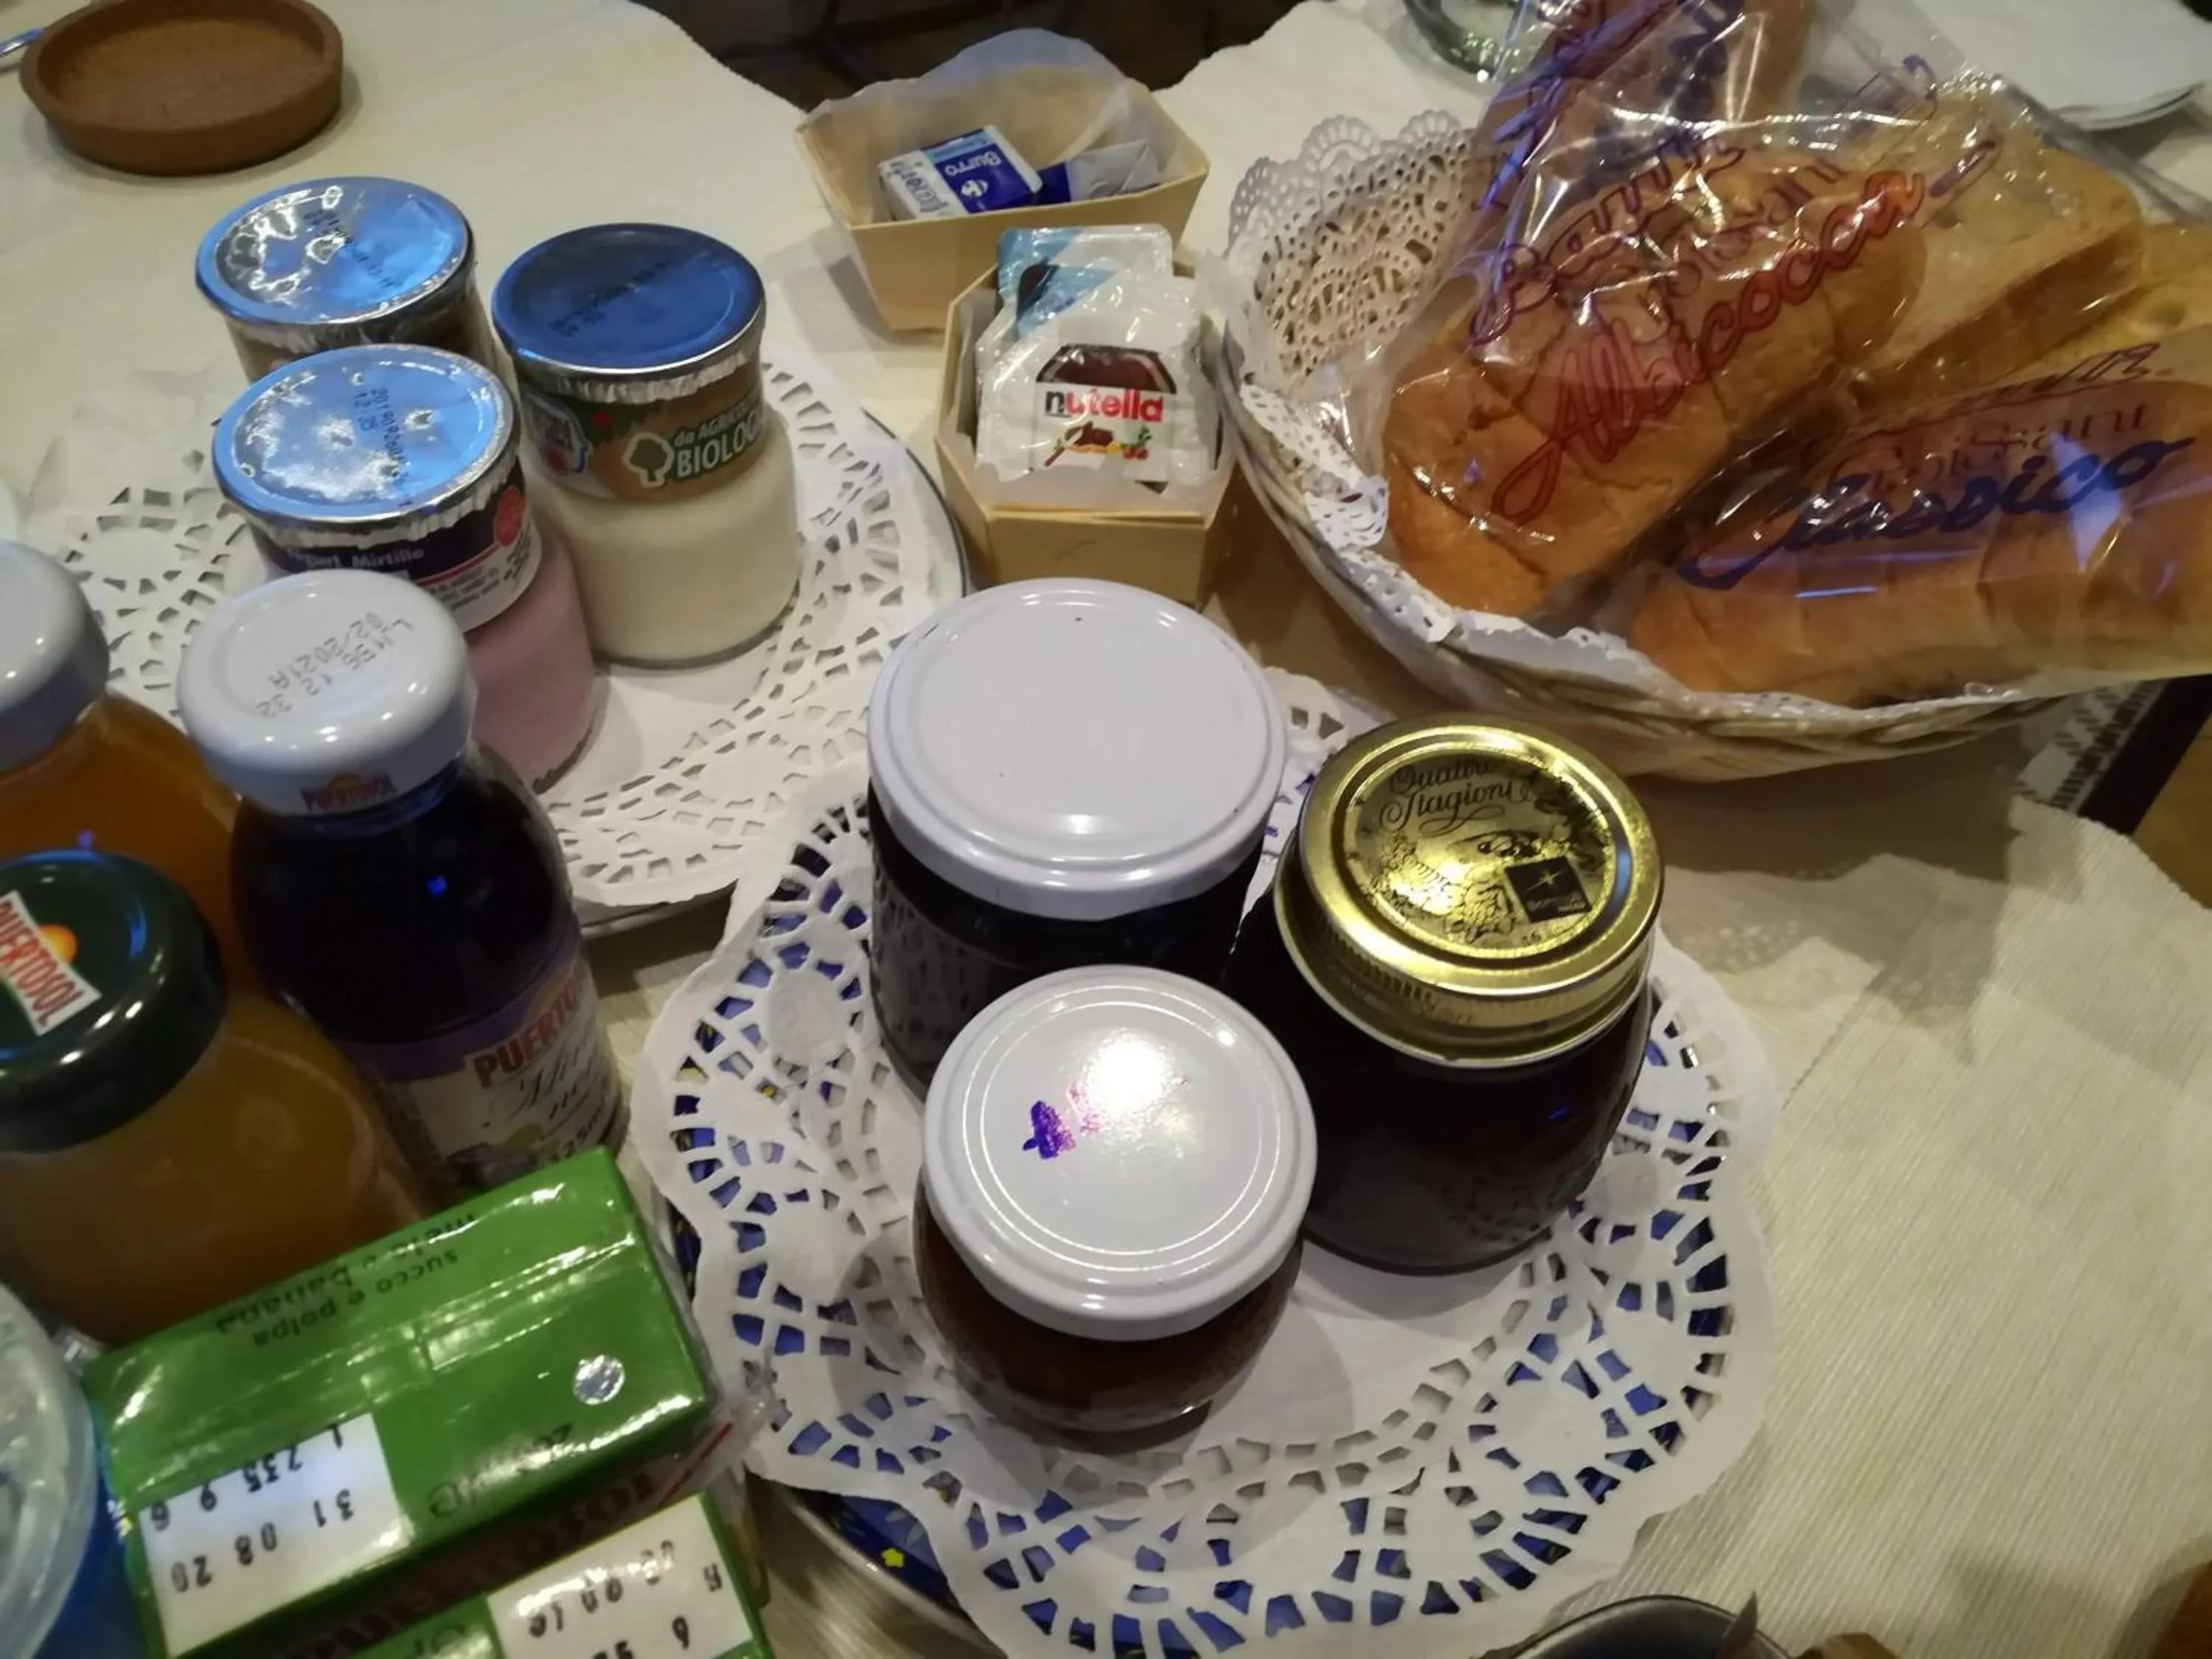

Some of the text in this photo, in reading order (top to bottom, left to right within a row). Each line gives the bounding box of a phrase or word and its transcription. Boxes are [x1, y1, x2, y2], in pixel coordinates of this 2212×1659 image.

[944, 150, 1003, 176] Burro
[1491, 170, 1926, 525] Albicocca
[1045, 388, 1164, 422] nutella
[352, 547, 425, 569] Mirtillo
[1677, 437, 2196, 590] Classico
[253, 1249, 459, 1346] succo e polpa
[170, 1489, 354, 1593] 31 08 20
